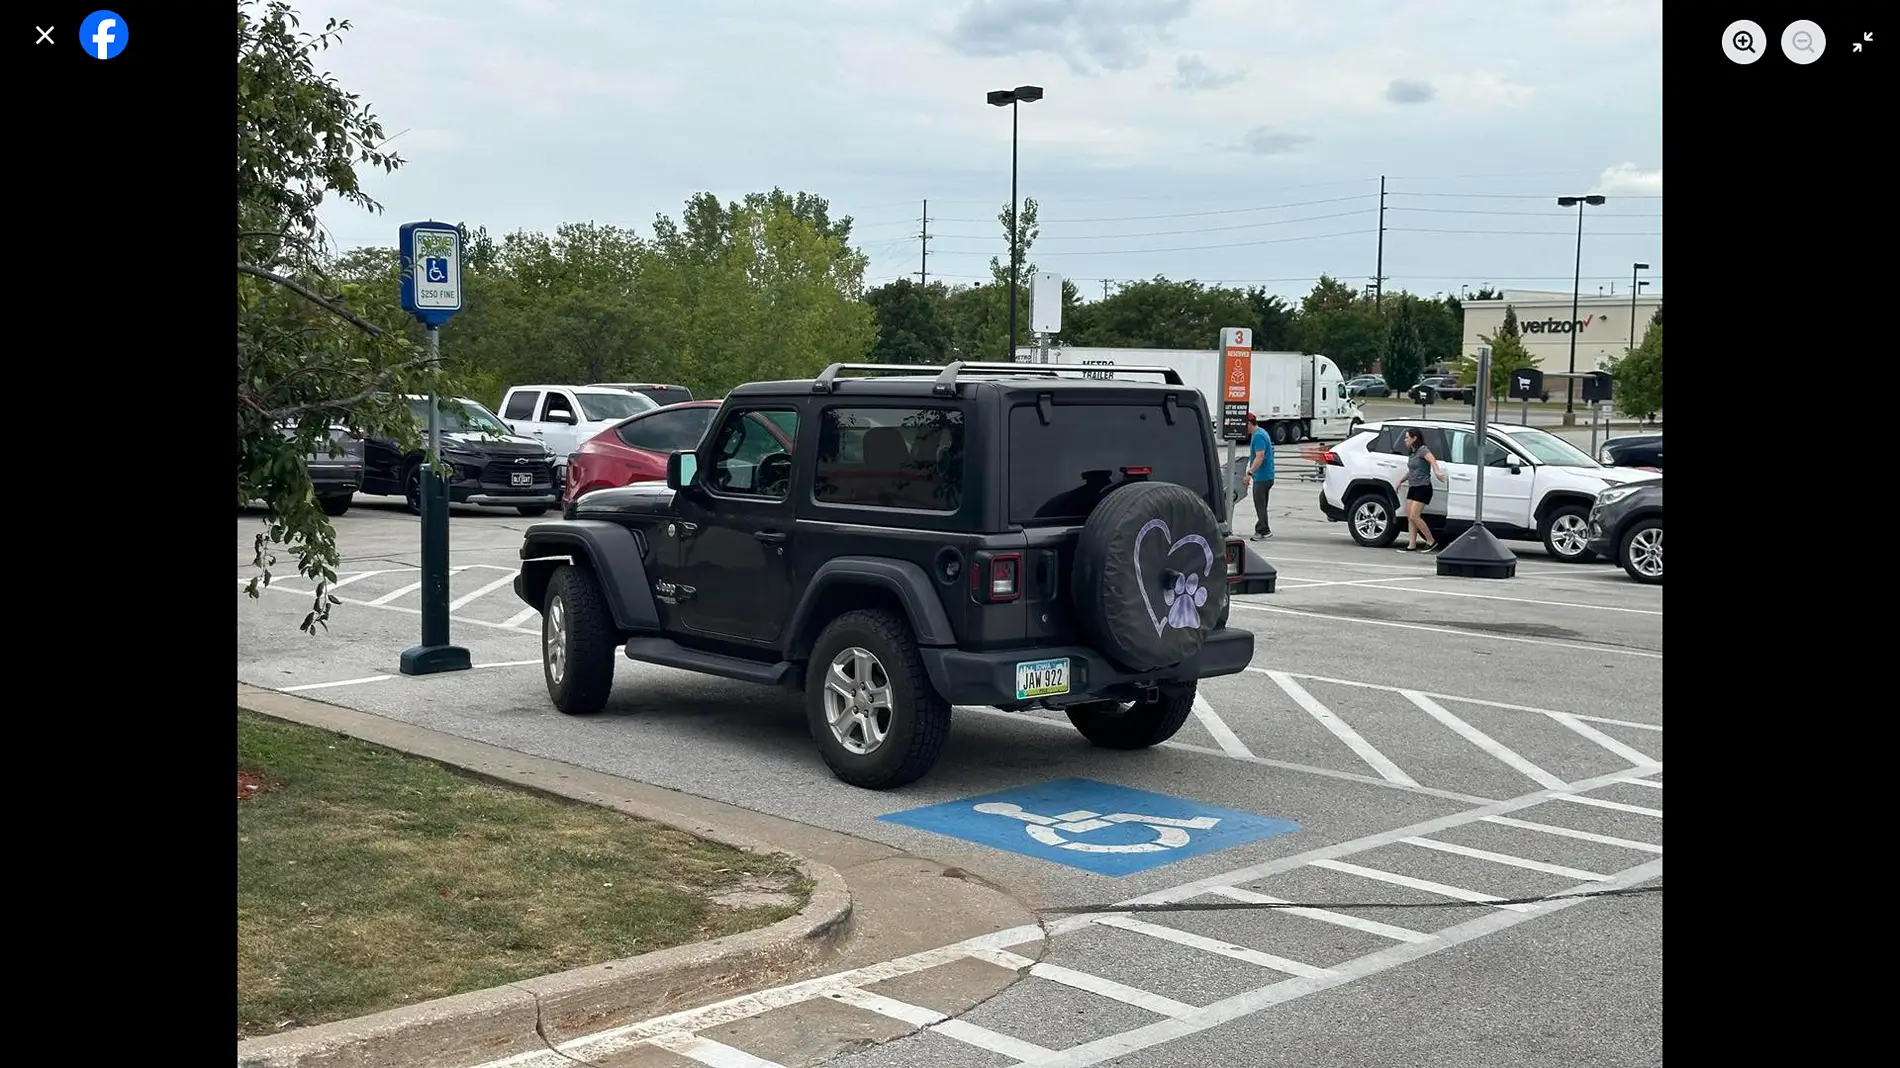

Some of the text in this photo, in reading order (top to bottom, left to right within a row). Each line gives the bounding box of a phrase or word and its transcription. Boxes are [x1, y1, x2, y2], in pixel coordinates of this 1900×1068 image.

[420, 289, 455, 299] $250 FINE
[1520, 317, 1583, 333] verizon
[1235, 330, 1244, 344] 3
[1227, 350, 1250, 358] RESERVED
[1082, 371, 1114, 380] TRAILER
[655, 578, 676, 596] Jeep
[1035, 663, 1051, 671] IOWA
[1023, 668, 1063, 690] JAW 922
